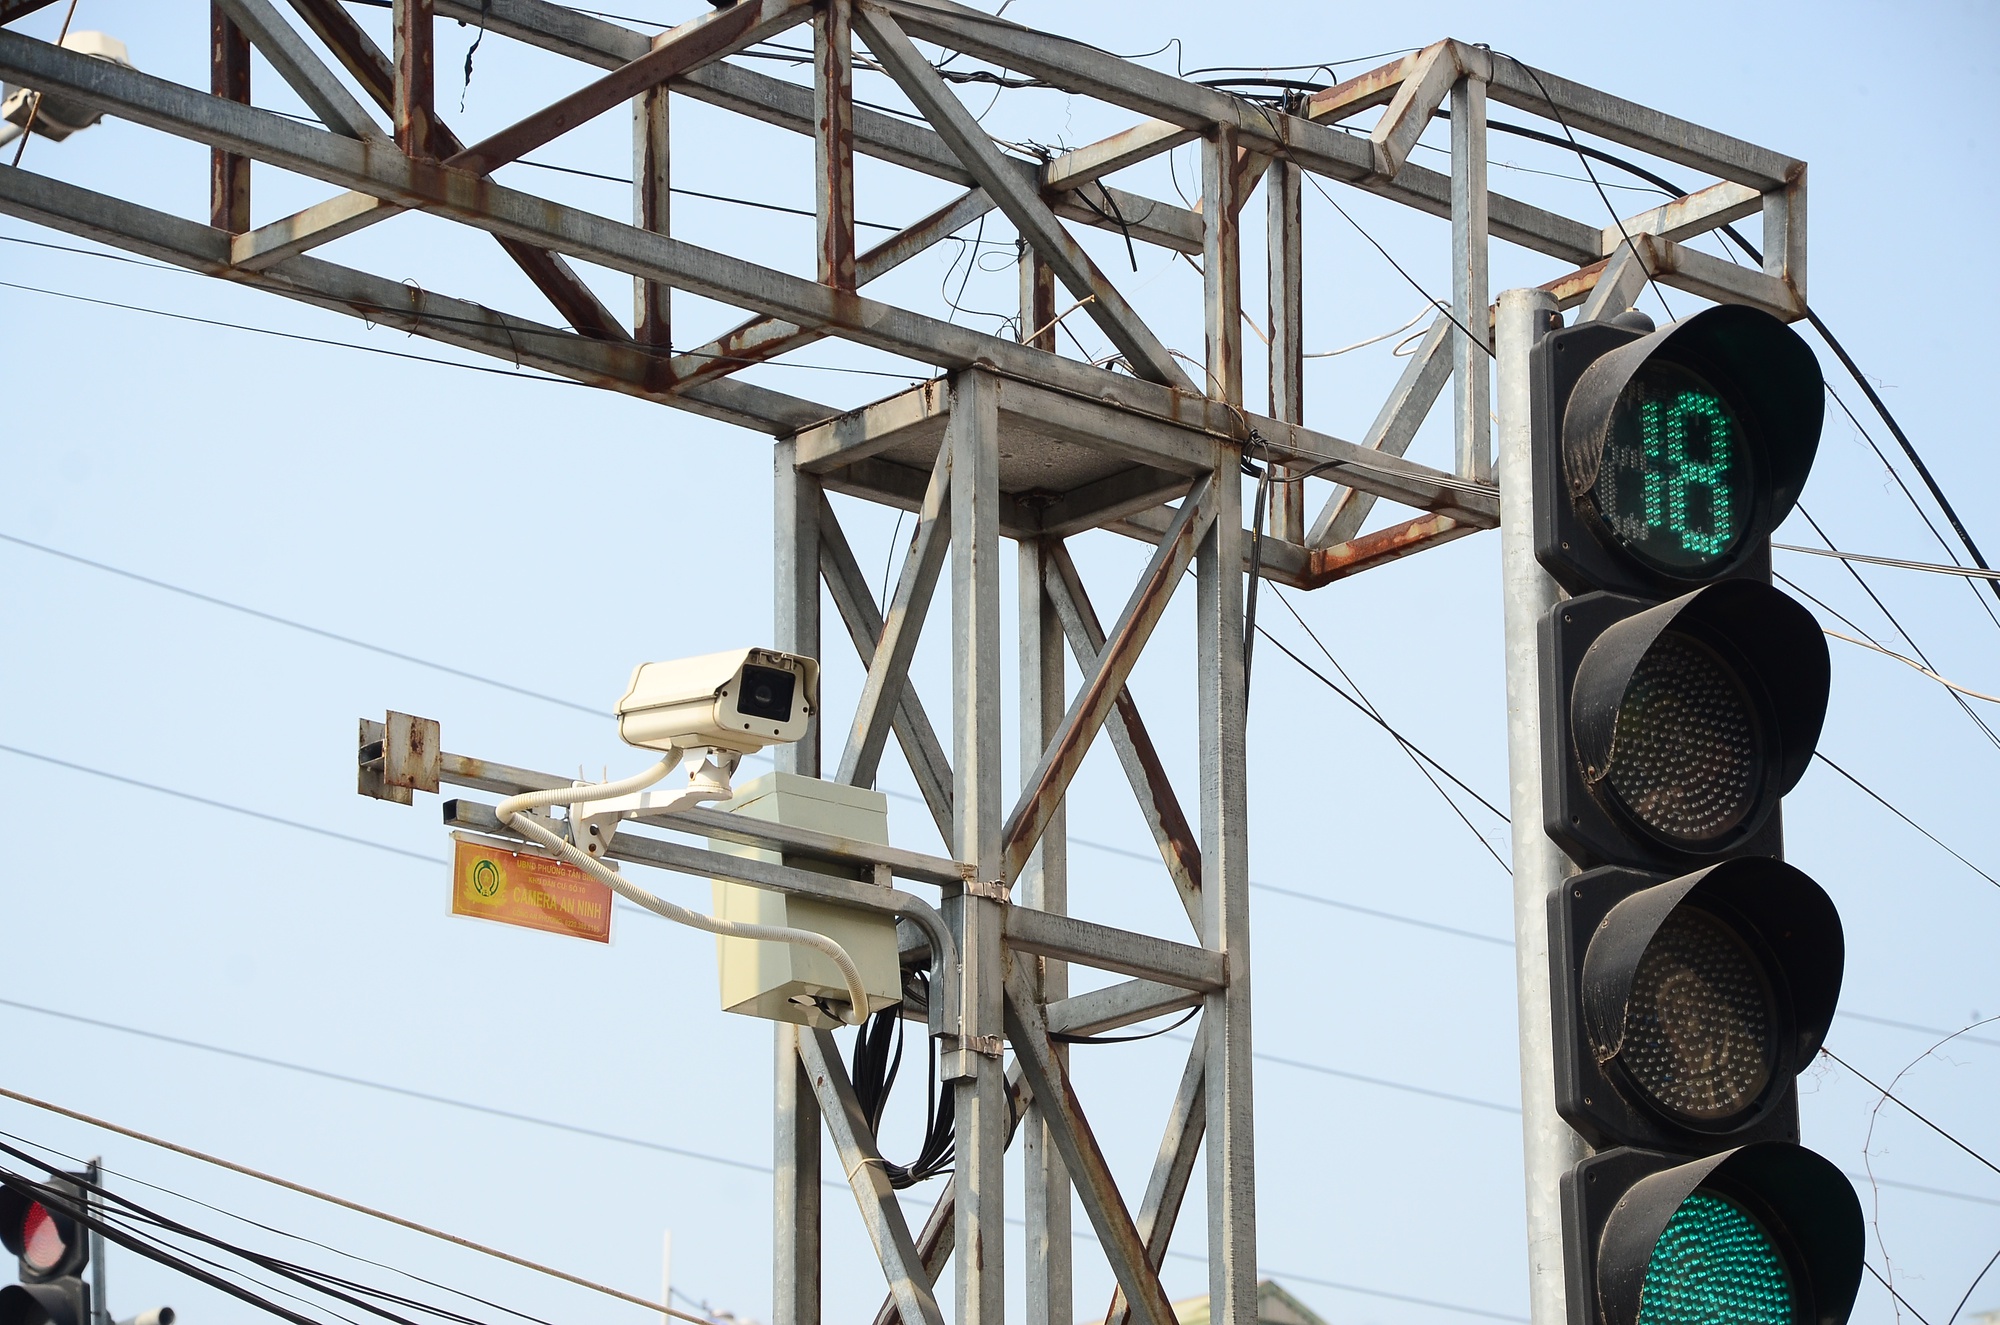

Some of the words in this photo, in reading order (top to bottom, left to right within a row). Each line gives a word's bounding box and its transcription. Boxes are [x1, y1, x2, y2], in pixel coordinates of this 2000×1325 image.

[1643, 391, 1732, 555] 18
[517, 860, 535, 870] UBND
[513, 886, 557, 910] CAMERA
[560, 896, 575, 914] AN
[577, 899, 602, 919] NINH
